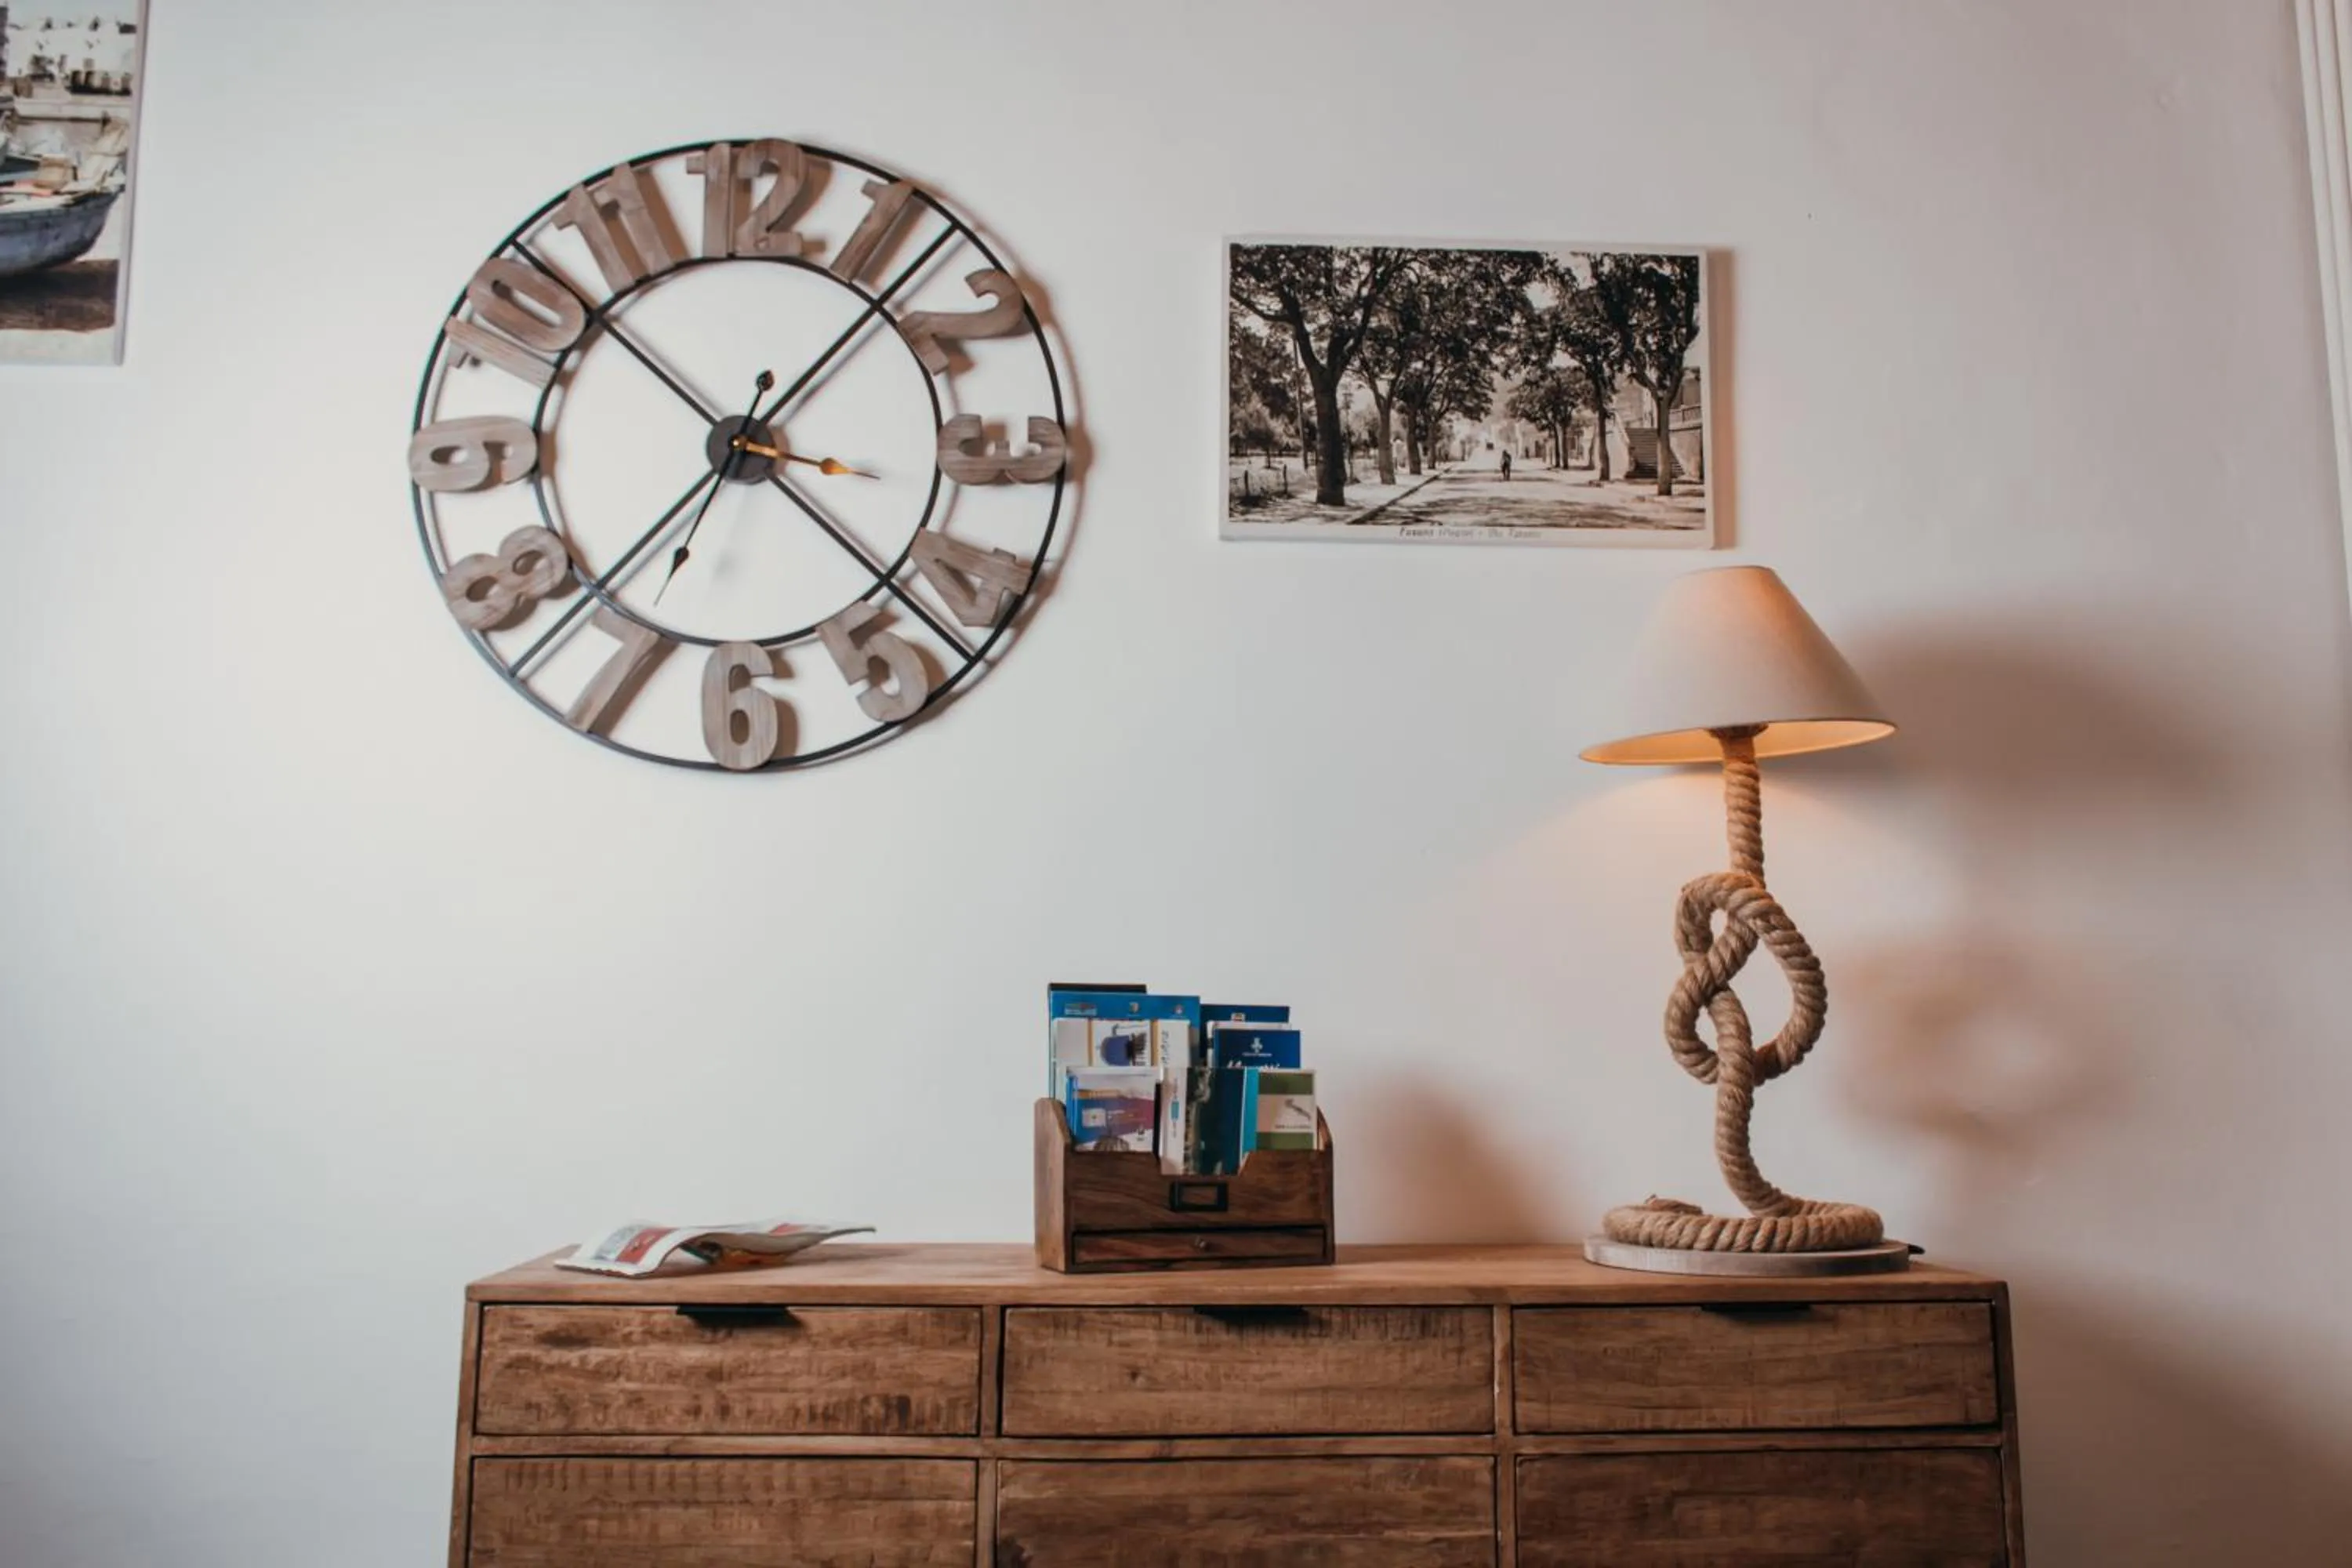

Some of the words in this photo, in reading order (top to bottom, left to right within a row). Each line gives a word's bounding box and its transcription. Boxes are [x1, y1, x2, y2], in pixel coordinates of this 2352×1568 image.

[553, 162, 684, 293] 11
[686, 139, 811, 257] 12
[830, 179, 915, 284] 1
[445, 257, 590, 388] 10
[898, 269, 1026, 376] 2
[409, 416, 538, 492] 9
[938, 414, 1065, 485] 3
[444, 525, 568, 630] 8
[909, 528, 1033, 626] 4
[565, 605, 662, 732] 7
[702, 642, 778, 771] 6
[816, 601, 927, 722] 5
